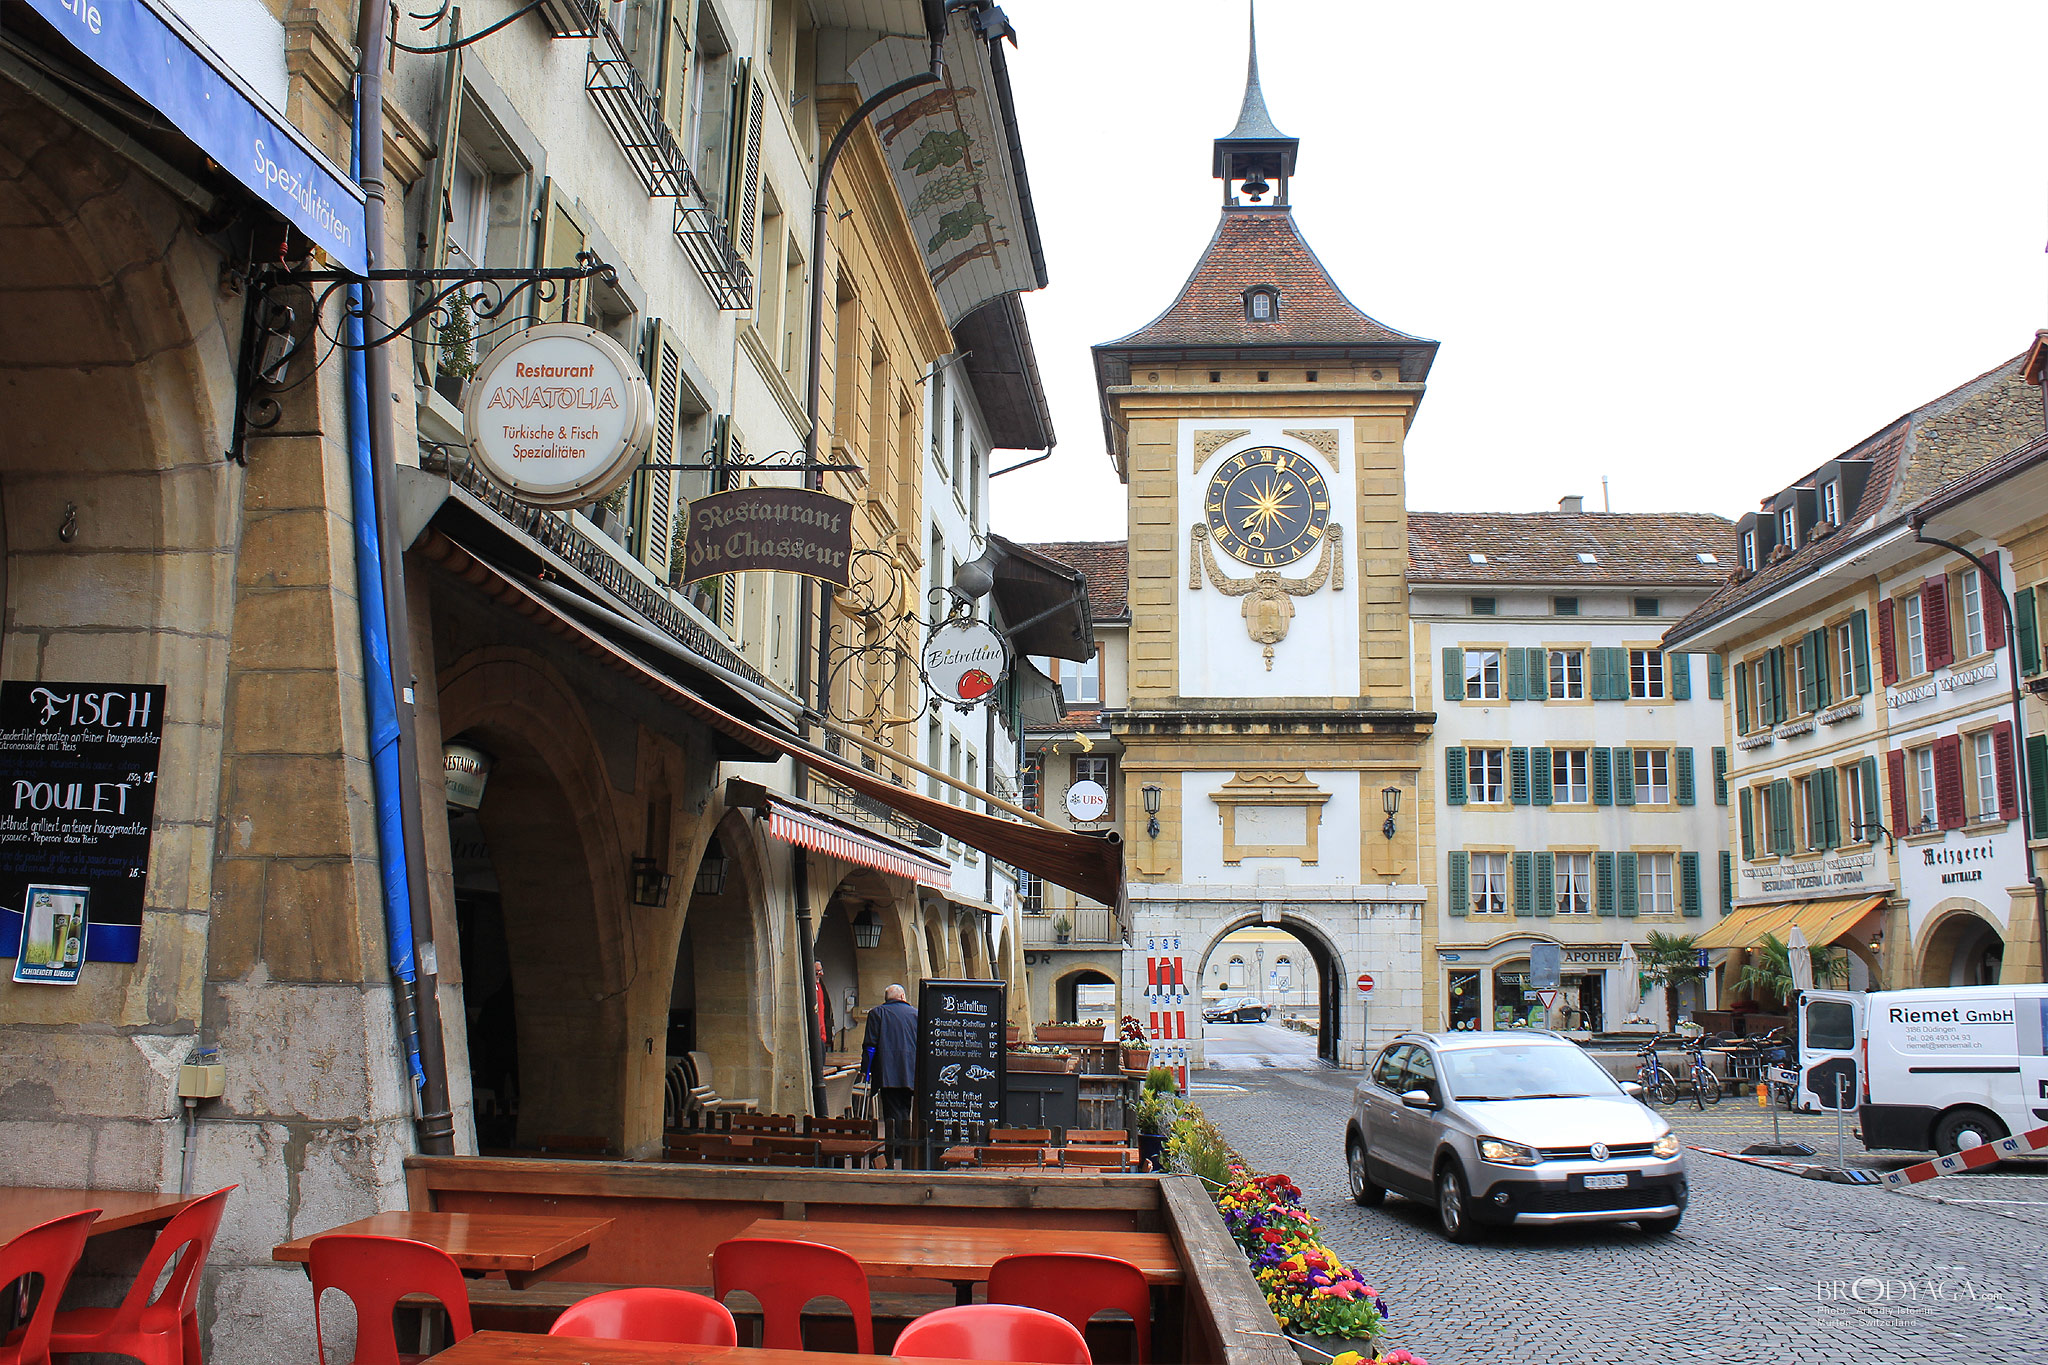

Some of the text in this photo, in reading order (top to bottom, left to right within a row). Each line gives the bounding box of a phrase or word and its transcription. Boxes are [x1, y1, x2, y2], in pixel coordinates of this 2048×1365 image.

[254, 139, 351, 248] Spezialitäten
[515, 362, 595, 378] Restaurant
[487, 386, 619, 410] ANATOLIA
[502, 424, 599, 440] Türkische & Fisch
[512, 443, 586, 462] Spezialitäten
[1260, 450, 1272, 461] XII
[697, 501, 841, 534] Restaurant
[690, 532, 845, 568] du Chasseur
[928, 645, 1001, 669] Bistrottino
[30, 687, 151, 728] FISCH
[0, 727, 160, 748] Zanderfilet gebraten an feiner hausgemachter
[47, 741, 59, 751] mit
[61, 741, 77, 751] Reis
[12, 779, 132, 815] POULET
[1082, 795, 1104, 805] UBS
[31, 816, 60, 833] grilliert
[61, 823, 71, 833] an
[71, 818, 92, 833] feiner
[94, 819, 148, 838] hausgemachter
[63, 834, 81, 843] dazu
[82, 834, 98, 844] Reis
[1922, 839, 1994, 867] Metzgerei
[1761, 871, 1864, 892] RESTAURANT PIZZERIA LA FONTANA
[1941, 870, 1982, 884] MARTHALER
[21, 967, 76, 978] SCHNEIDER WEISSE
[943, 996, 988, 1013] Bistrottino
[1889, 1008, 2014, 1023] Riemet GmbH
[1922, 1026, 1956, 1034] Düdingen
[1906, 1042, 1982, 1050] riemet@sensemail.ch
